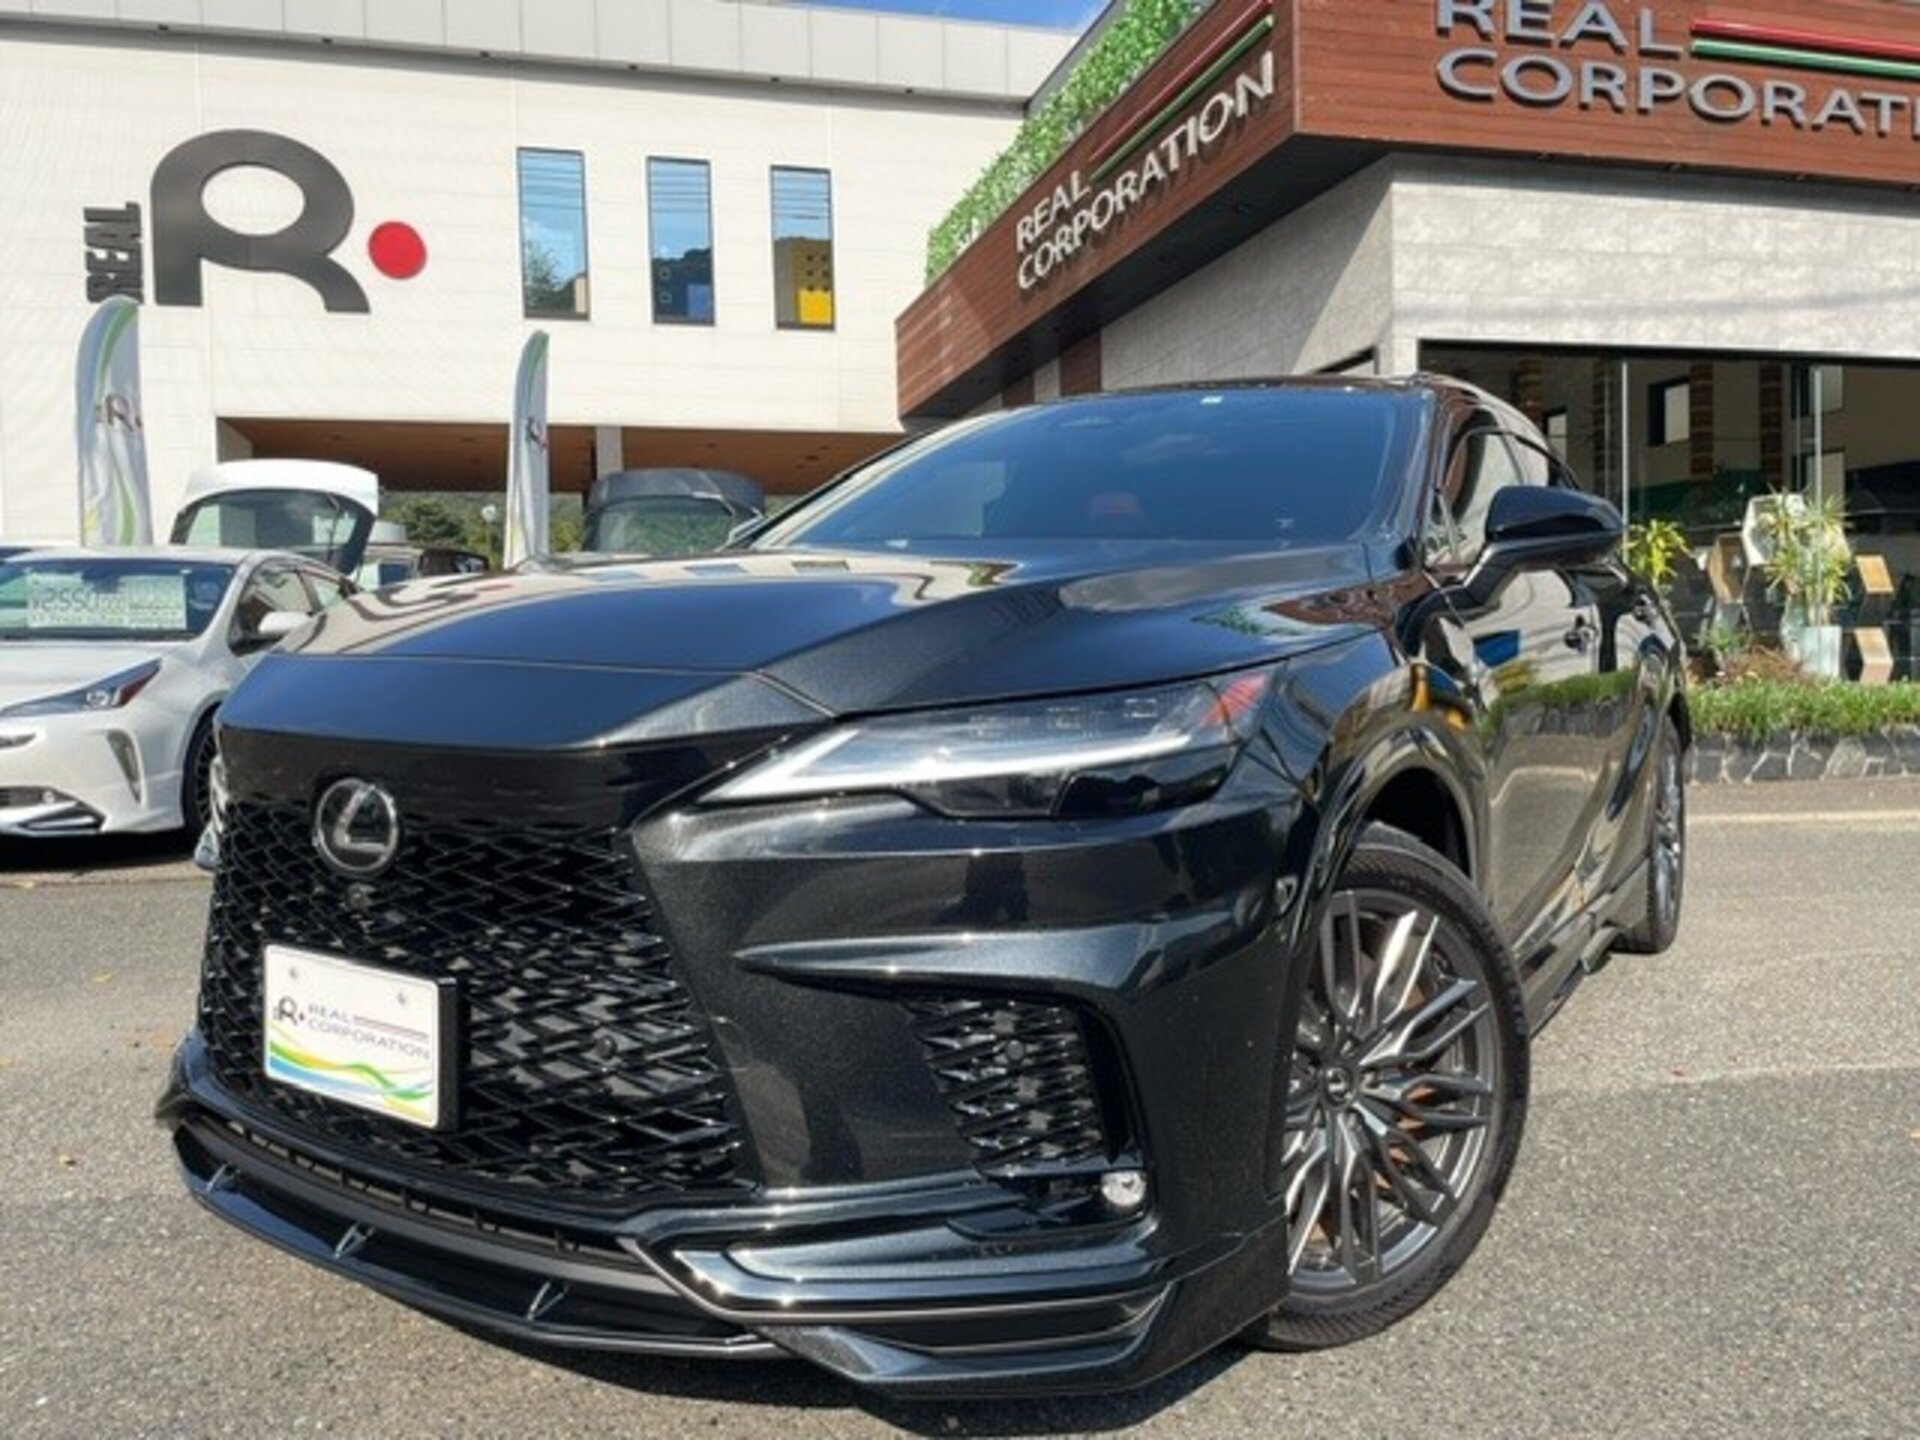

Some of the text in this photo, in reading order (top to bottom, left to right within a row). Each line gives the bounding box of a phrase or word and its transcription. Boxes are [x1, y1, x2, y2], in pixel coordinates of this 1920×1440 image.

[1436, 0, 1684, 56] REAL
[1018, 50, 1274, 289] CORPORATION
[1016, 170, 1091, 252] REAL
[308, 1003, 351, 1024] REAL
[308, 1017, 430, 1061] CORPORATION
